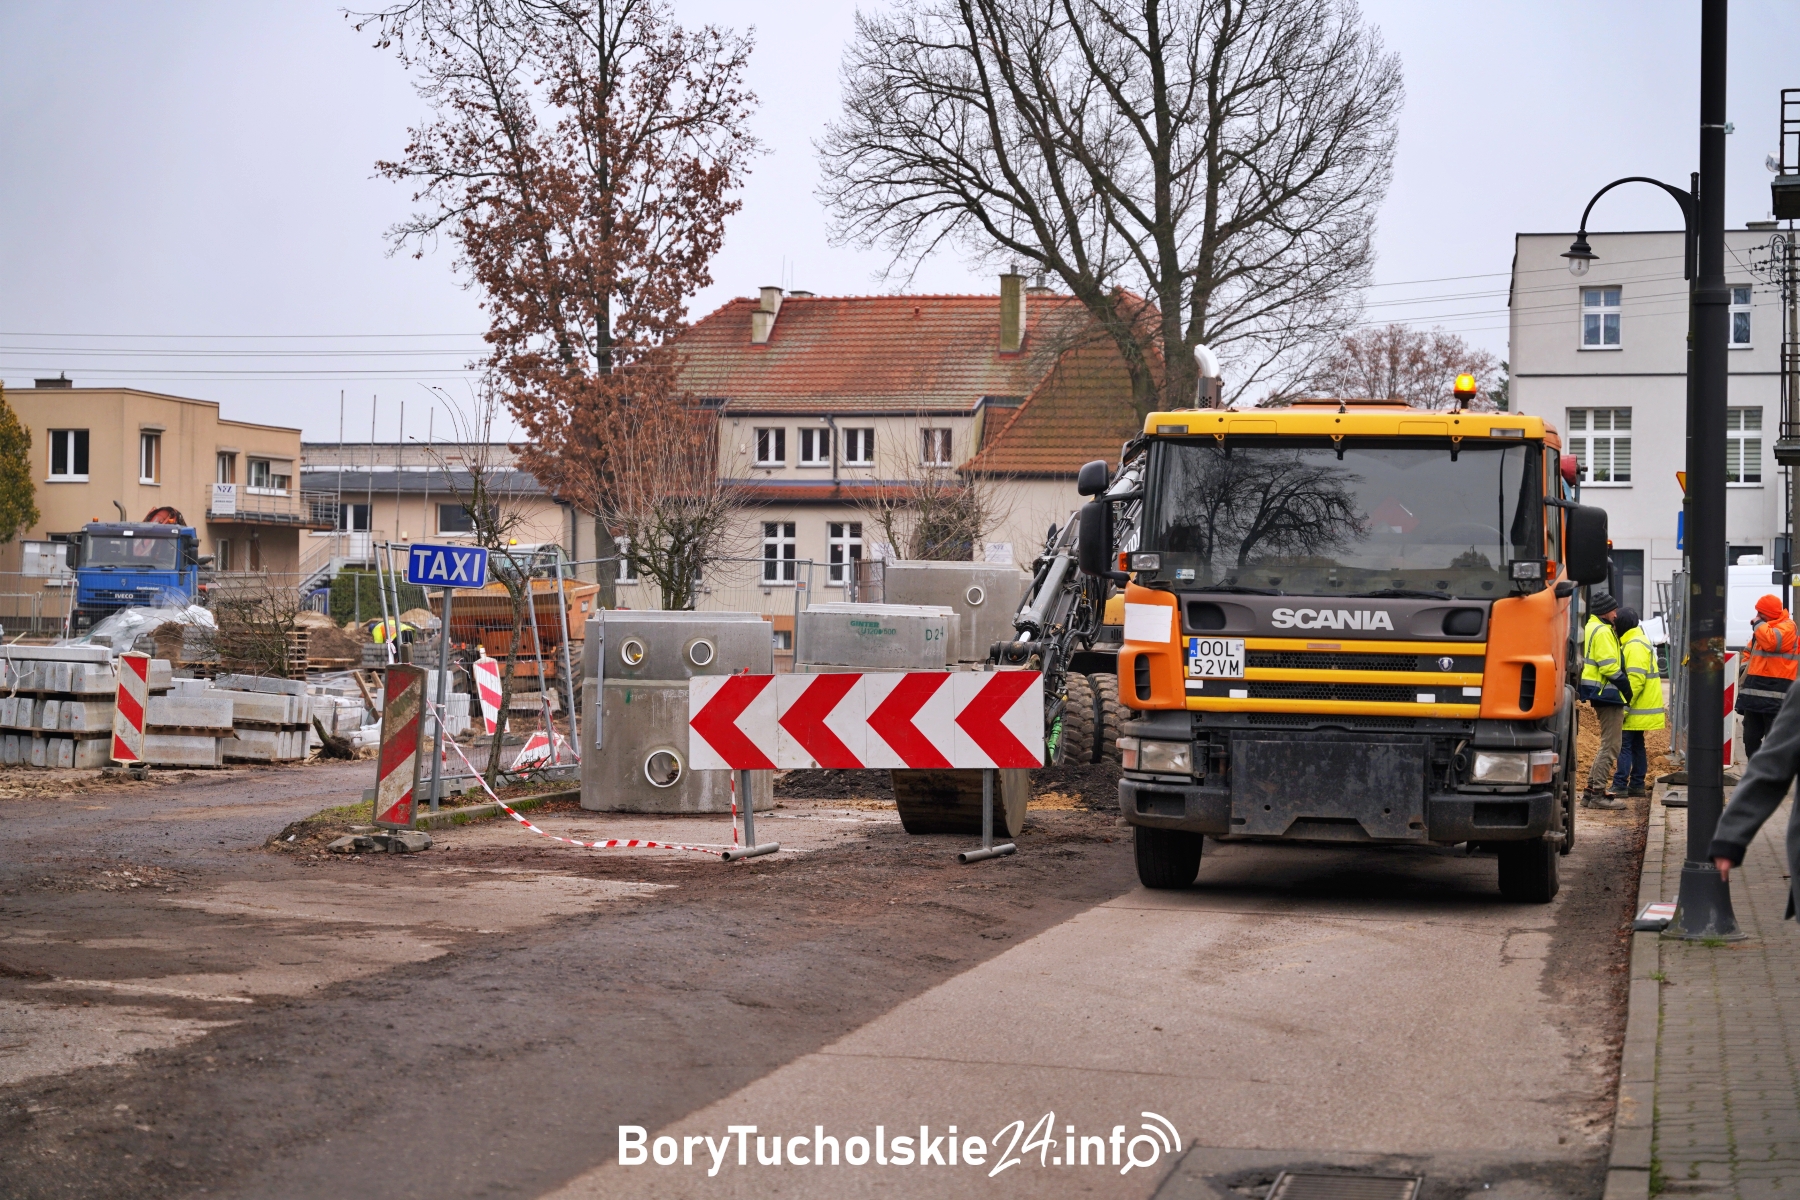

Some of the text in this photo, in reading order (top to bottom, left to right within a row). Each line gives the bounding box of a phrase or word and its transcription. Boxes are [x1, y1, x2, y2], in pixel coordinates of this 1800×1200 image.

[413, 549, 481, 582] TAXI
[850, 620, 880, 628] GINTER
[1271, 608, 1394, 631] SCANIA
[1194, 659, 1239, 676] 52VM
